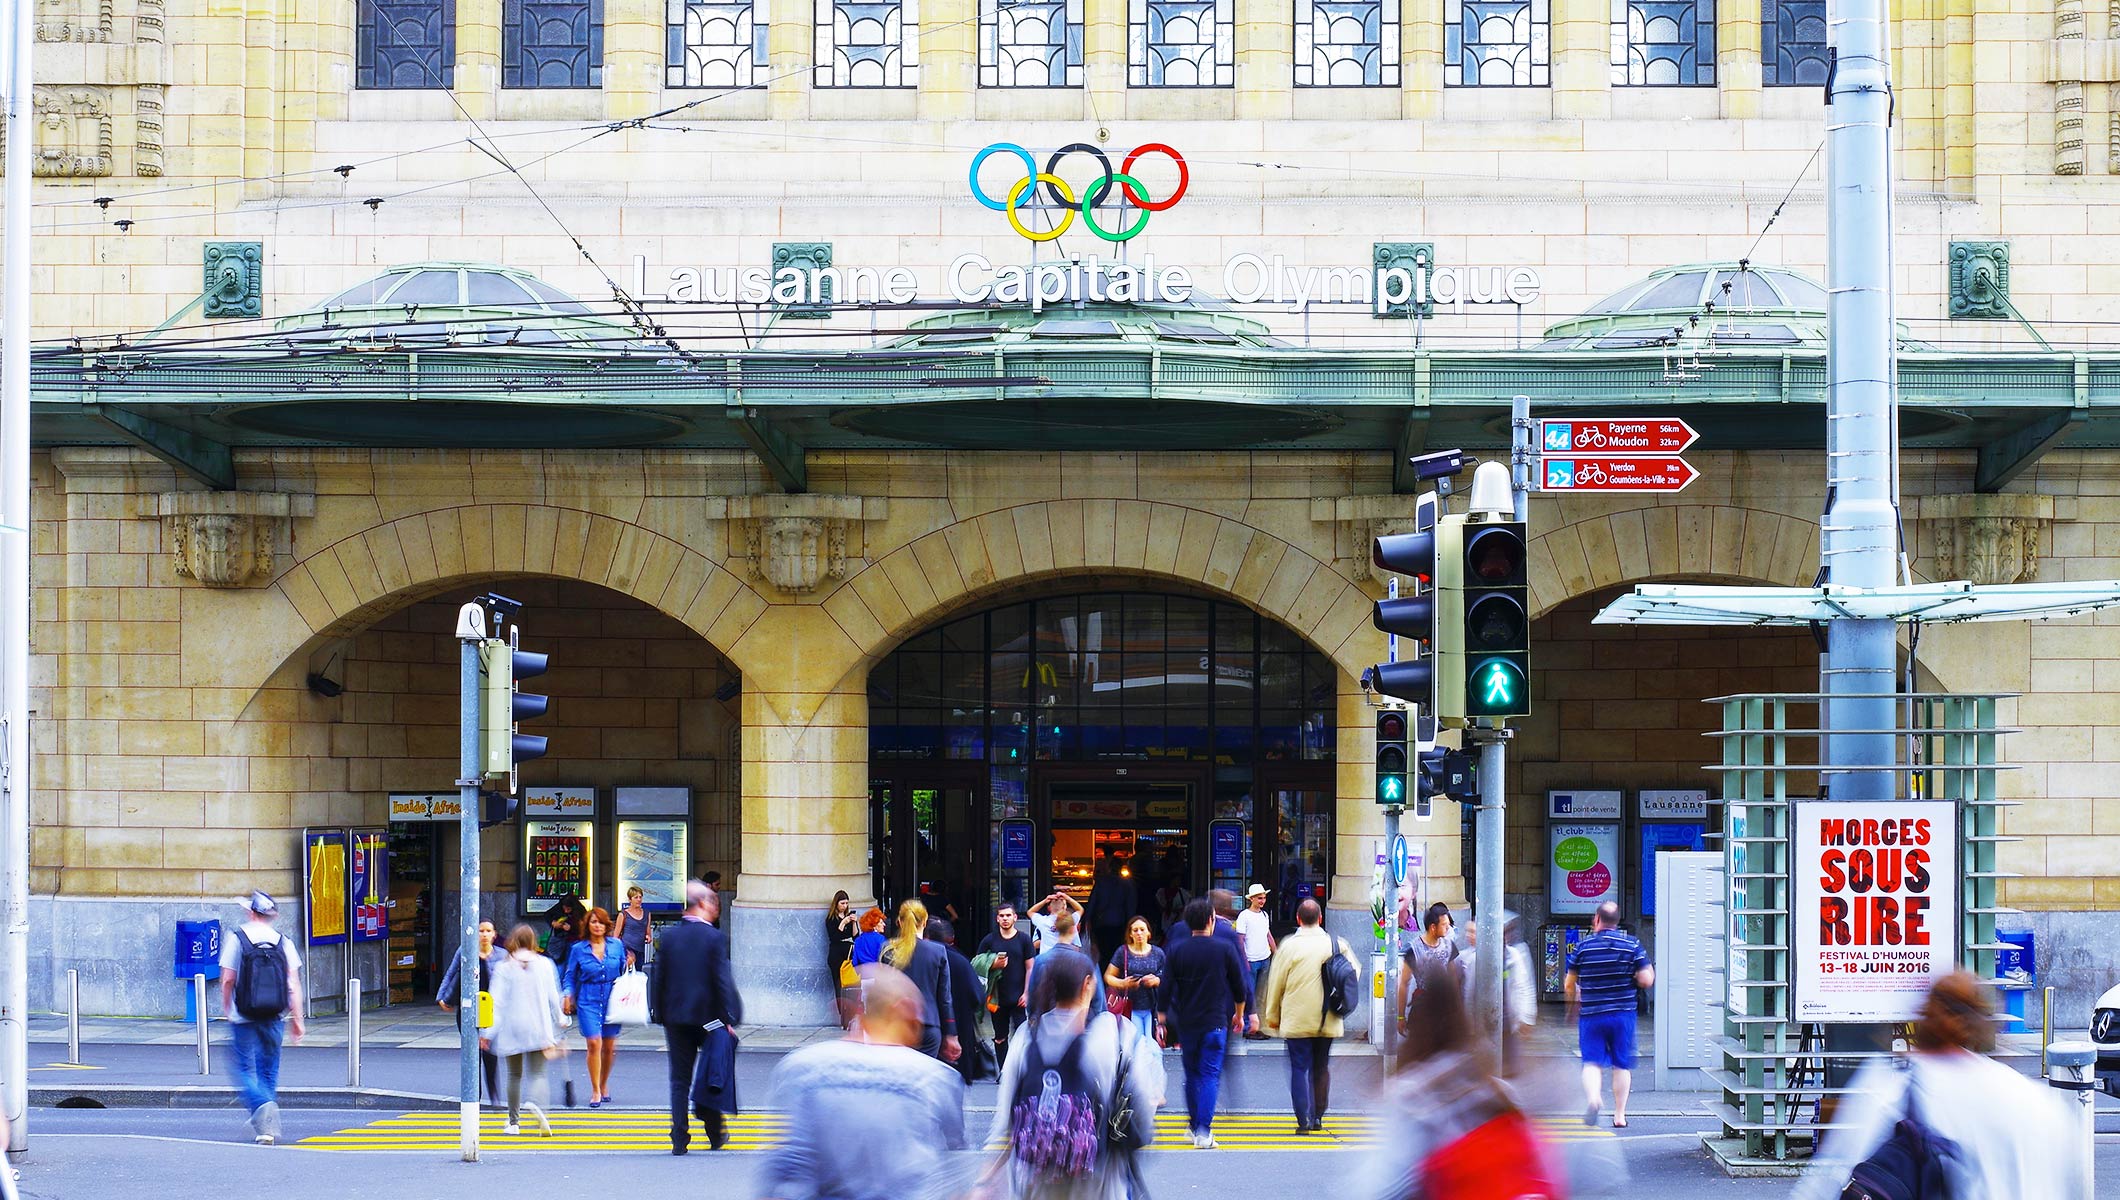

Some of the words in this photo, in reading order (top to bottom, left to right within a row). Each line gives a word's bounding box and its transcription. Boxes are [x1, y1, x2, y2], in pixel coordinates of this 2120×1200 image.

[632, 254, 918, 304] Lausanne
[947, 252, 1193, 313] Capitale
[1222, 252, 1542, 314] Olympique
[1609, 423, 1647, 435] Payerne
[1660, 425, 1679, 433] 56km
[1545, 430, 1569, 448] 44
[1609, 436, 1649, 446] Moudon
[1660, 438, 1679, 446] 32km
[1609, 462, 1636, 472] Yverdon
[1548, 472, 1572, 487] 22
[393, 799, 427, 814] Inside
[432, 800, 461, 815] Afric
[527, 795, 556, 806] Inside
[562, 796, 592, 807] Africa
[1644, 800, 1703, 809] Lausanne
[1573, 806, 1589, 814] point
[1820, 819, 1931, 846] MORGES
[1820, 848, 1931, 893] SOUS
[1820, 896, 1931, 945] RIRE
[1820, 952, 1870, 960] FESTIVAL
[1873, 952, 1930, 960] D'HUMOUR
[1861, 963, 1895, 973] JUIN
[1898, 963, 1930, 973] 2016
